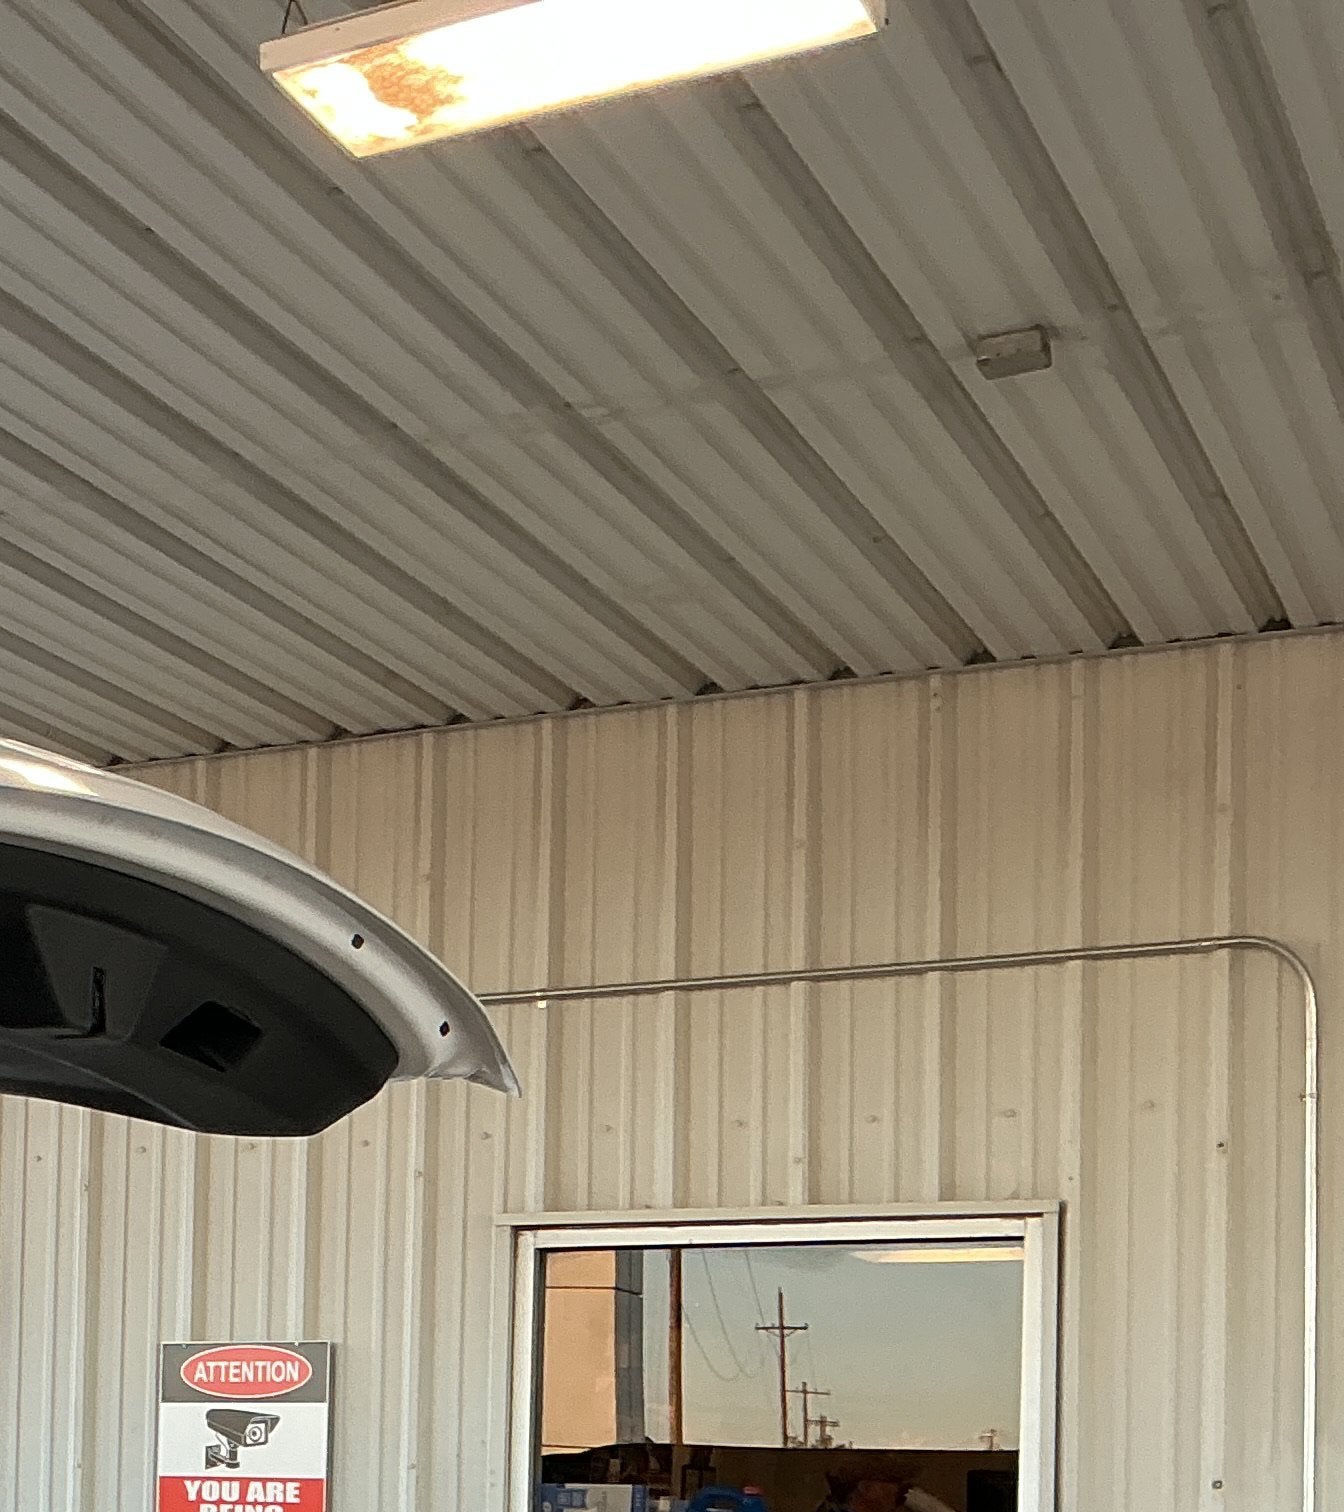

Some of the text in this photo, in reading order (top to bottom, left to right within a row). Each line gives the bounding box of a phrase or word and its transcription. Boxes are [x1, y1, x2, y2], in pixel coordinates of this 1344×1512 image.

[193, 1360, 300, 1383] ATTENTION
[183, 1480, 301, 1504] YOU ARE
